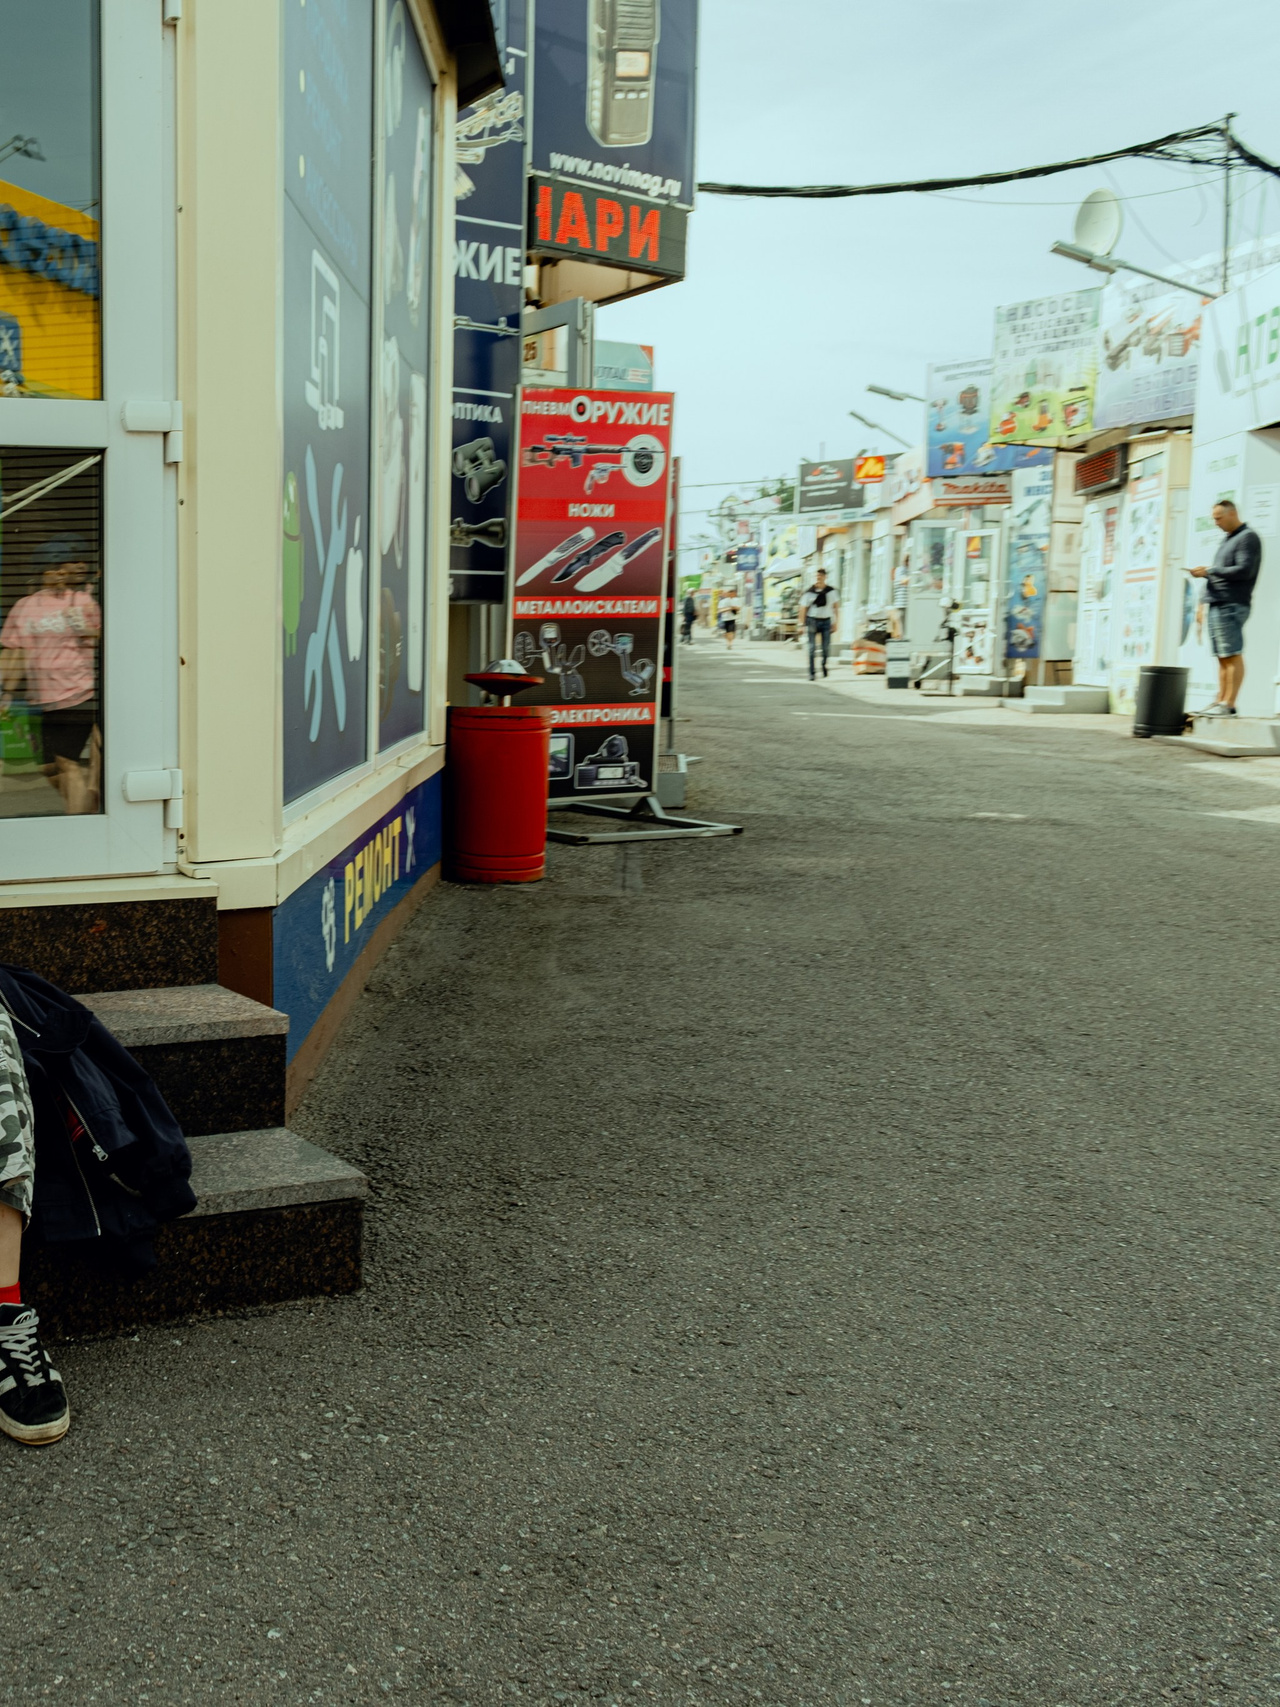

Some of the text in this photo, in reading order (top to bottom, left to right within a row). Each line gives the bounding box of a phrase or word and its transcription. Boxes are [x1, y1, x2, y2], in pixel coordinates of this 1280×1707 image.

[568, 501, 615, 519] НОЖИ
[515, 599, 658, 617] МЕТАЛЛОИСКАТЕЛИ
[550, 706, 652, 724] ЭЛЕКТРОНИКА
